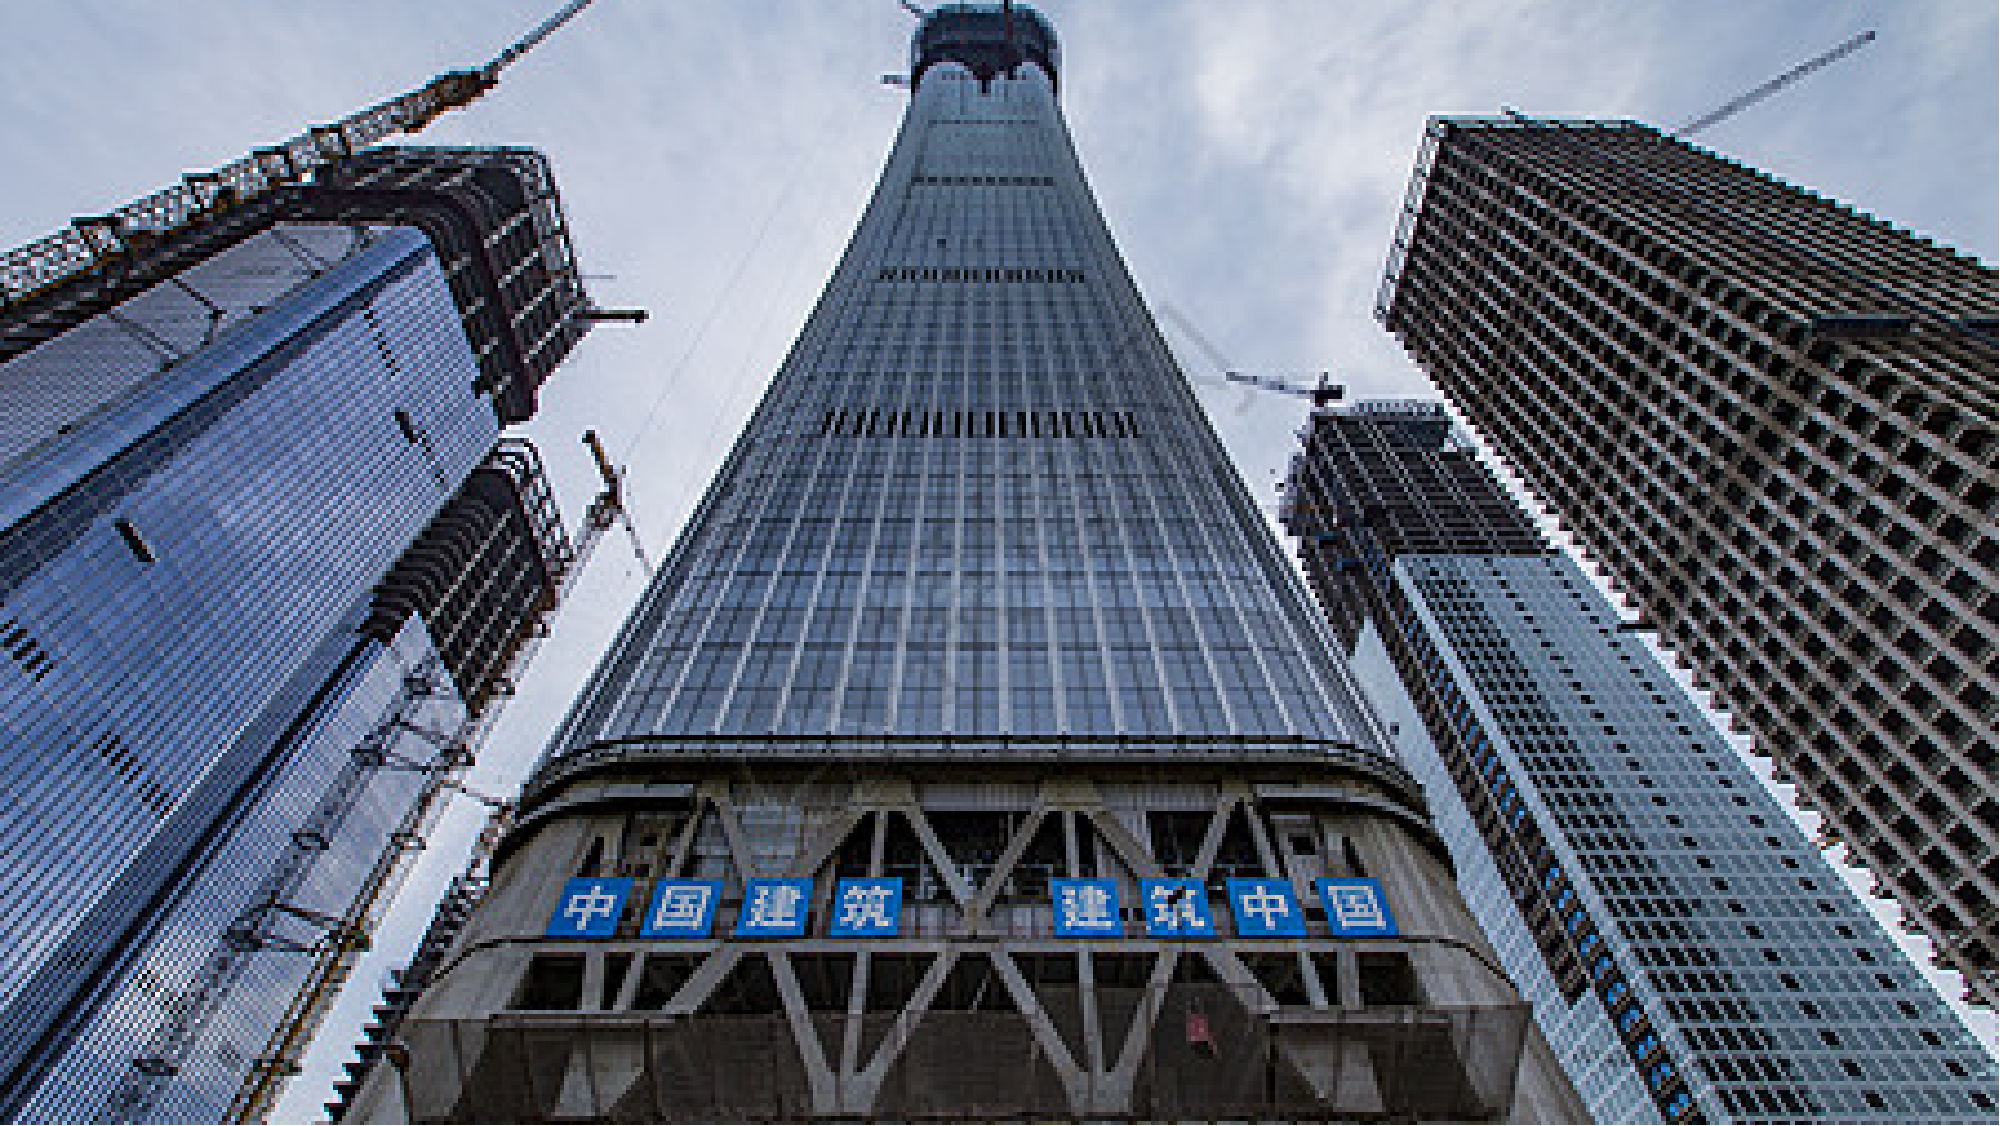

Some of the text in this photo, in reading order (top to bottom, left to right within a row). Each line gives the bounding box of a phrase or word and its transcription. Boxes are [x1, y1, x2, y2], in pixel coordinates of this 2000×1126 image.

[564, 886, 894, 930] 中国建筑
[1061, 886, 1387, 930] 建筑中国
